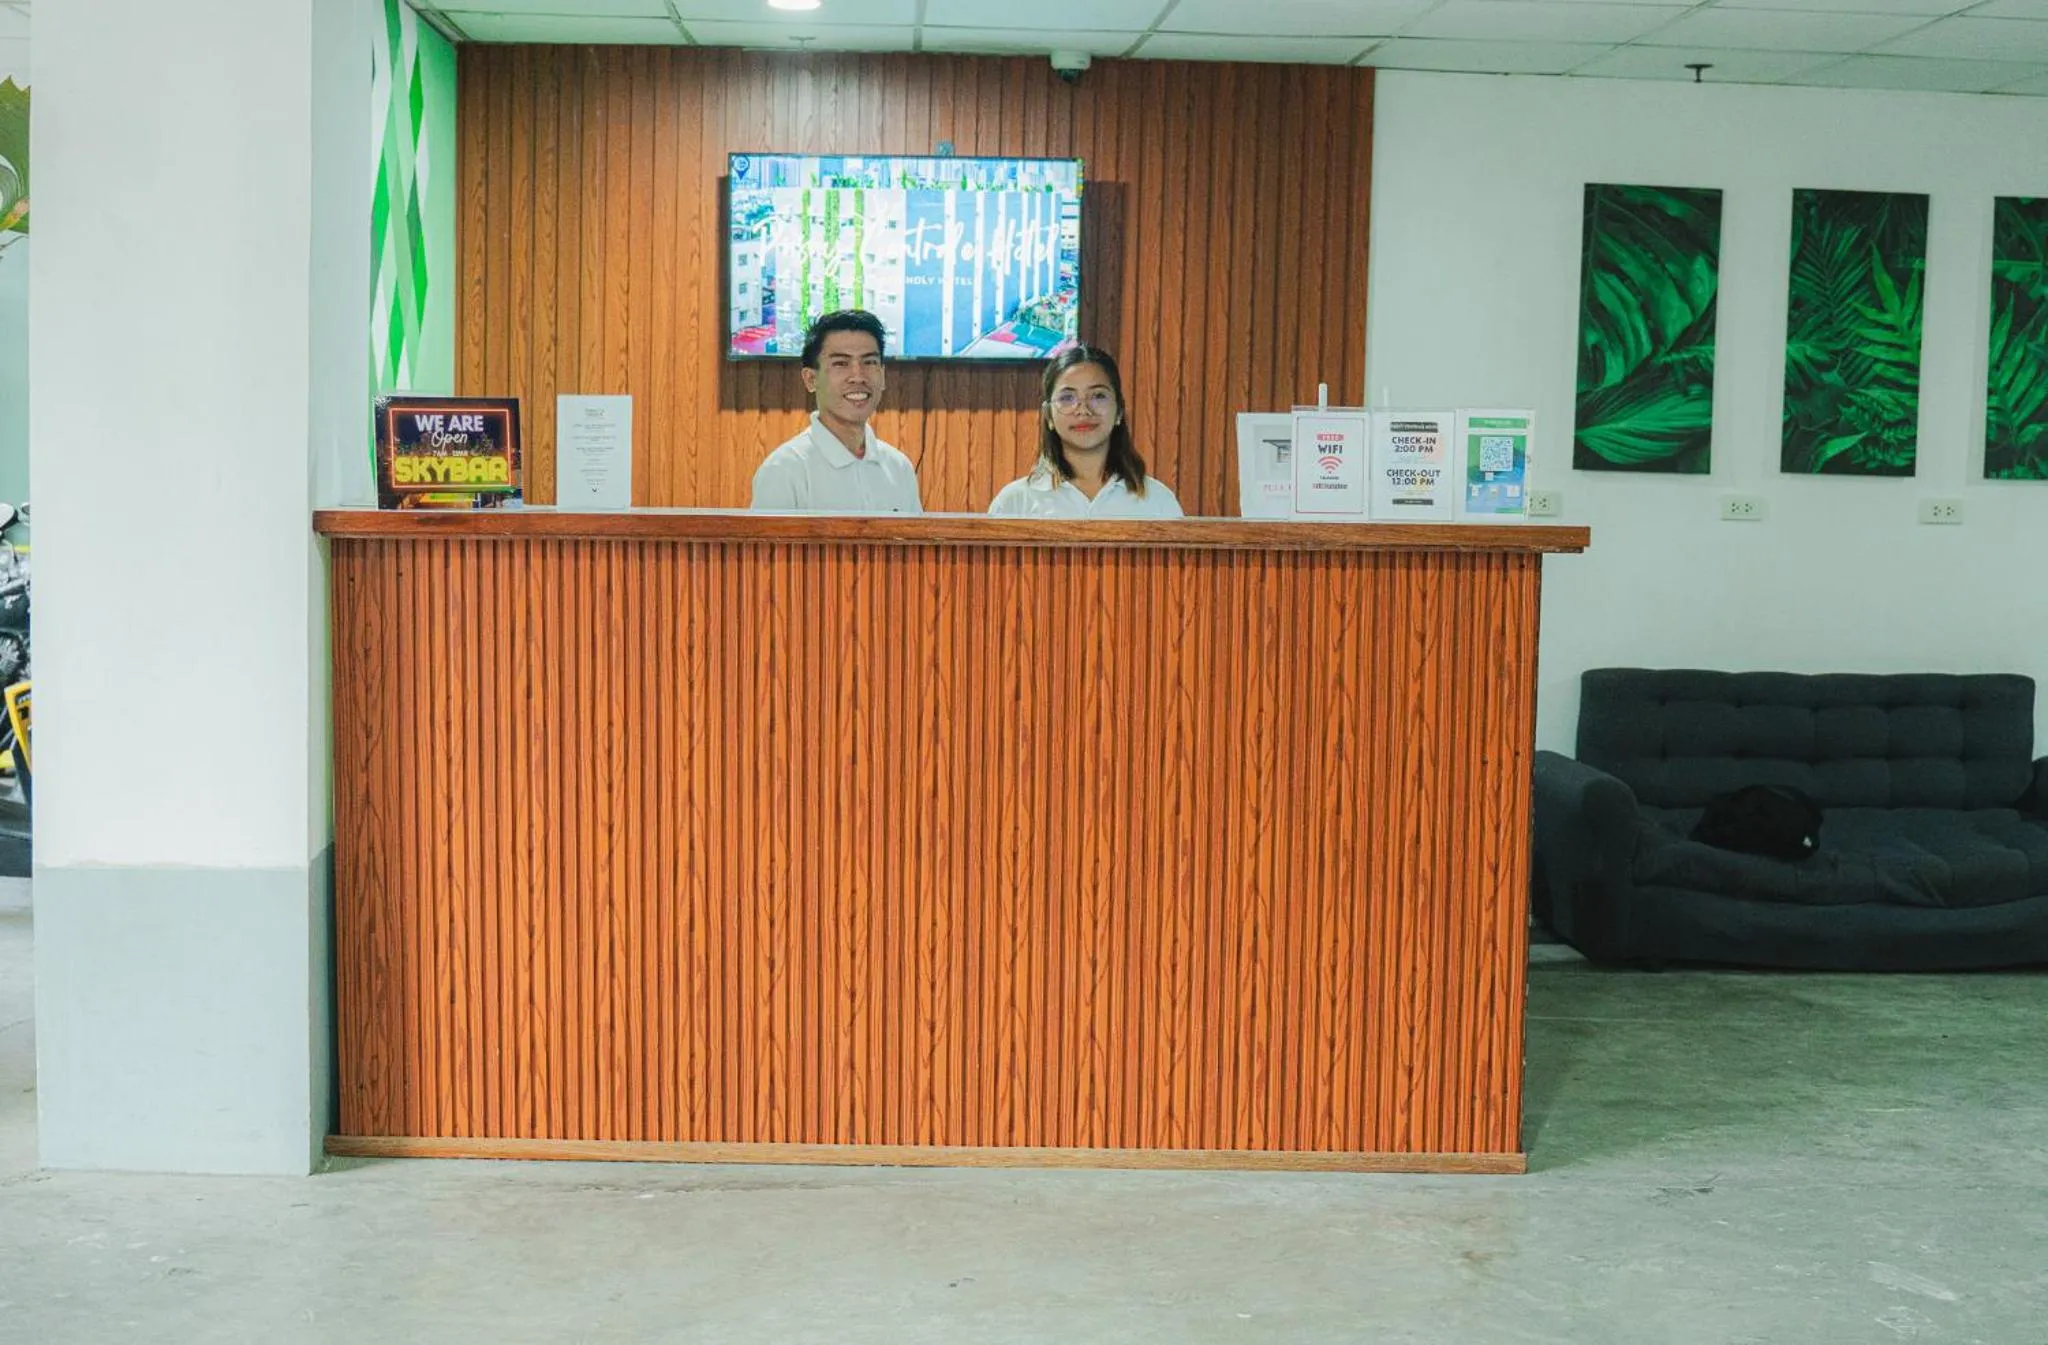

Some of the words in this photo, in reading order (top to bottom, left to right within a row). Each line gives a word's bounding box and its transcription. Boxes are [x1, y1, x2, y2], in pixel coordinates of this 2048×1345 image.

[414, 414, 444, 432] WE
[447, 414, 485, 432] ARE
[430, 428, 468, 451] Open
[1391, 436, 1437, 445] CHECK-IN
[1317, 444, 1343, 454] WIFI
[1395, 445, 1416, 453] 2:00
[1418, 445, 1434, 453] PM
[395, 457, 508, 482] SKYBAR
[1386, 469, 1441, 478] CHECK-OUT
[1420, 478, 1435, 486] PM
